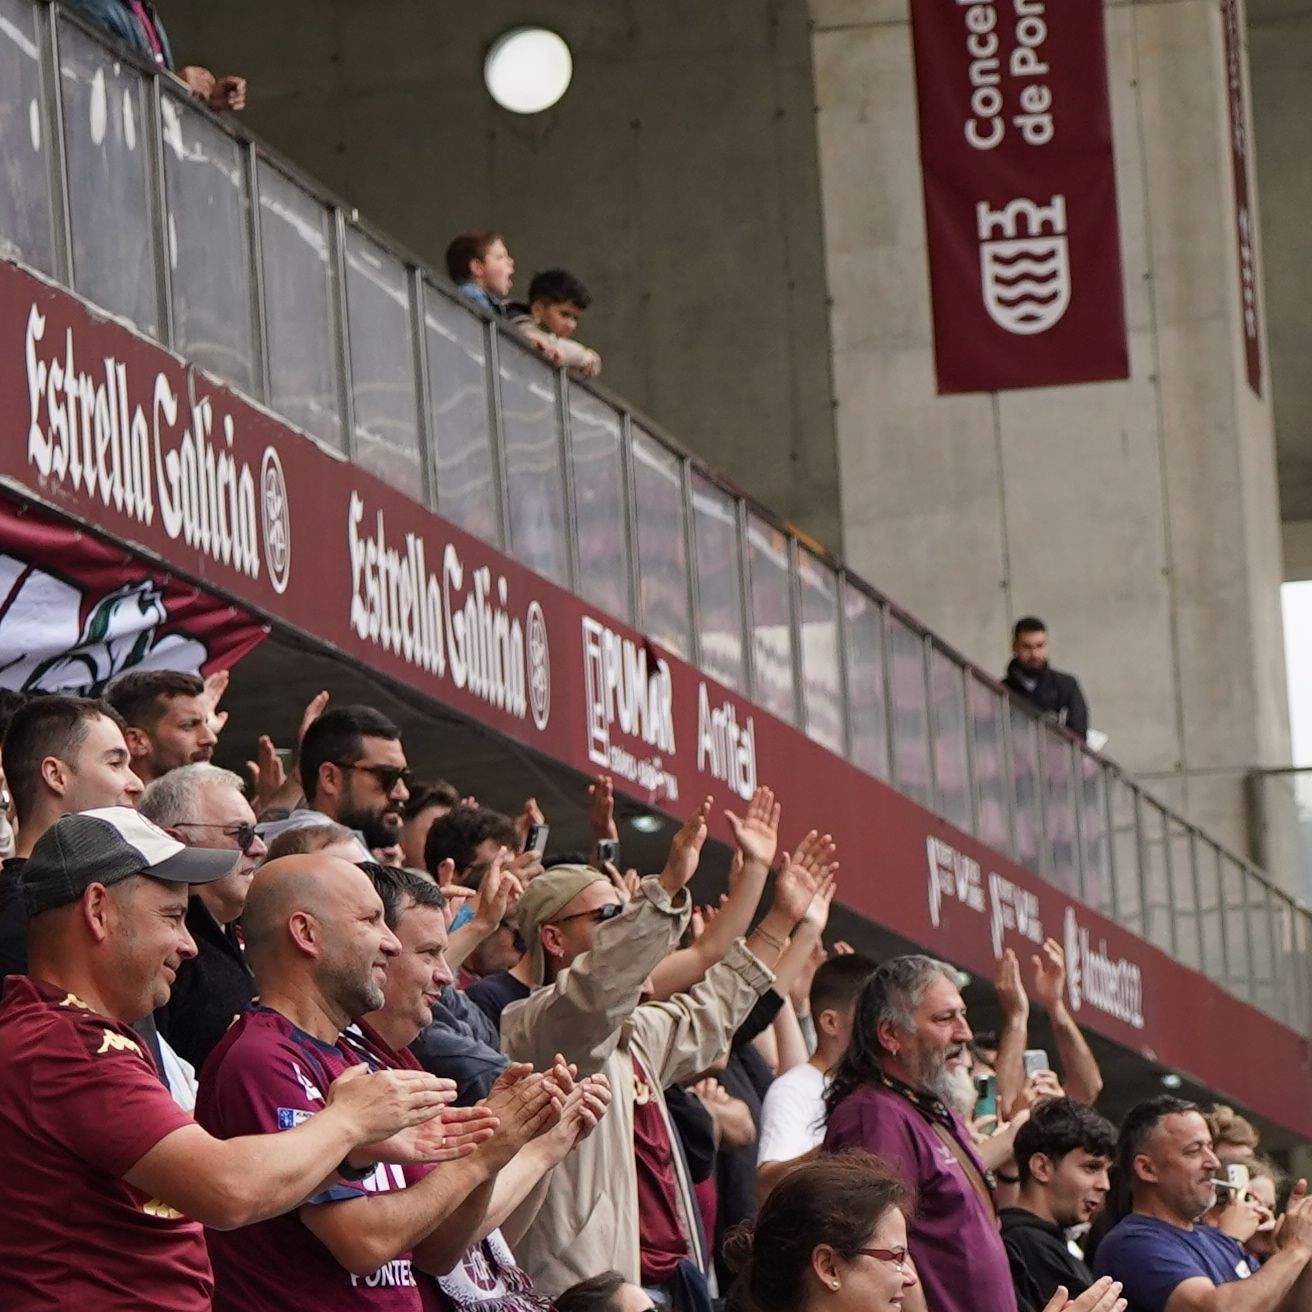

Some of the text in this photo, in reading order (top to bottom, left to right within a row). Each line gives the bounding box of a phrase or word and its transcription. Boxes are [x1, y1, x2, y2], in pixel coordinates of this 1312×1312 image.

[1013, 84, 1054, 146] de
[26, 303, 260, 580] Estrella Galicia
[348, 490, 527, 719] Estrella Galicia
